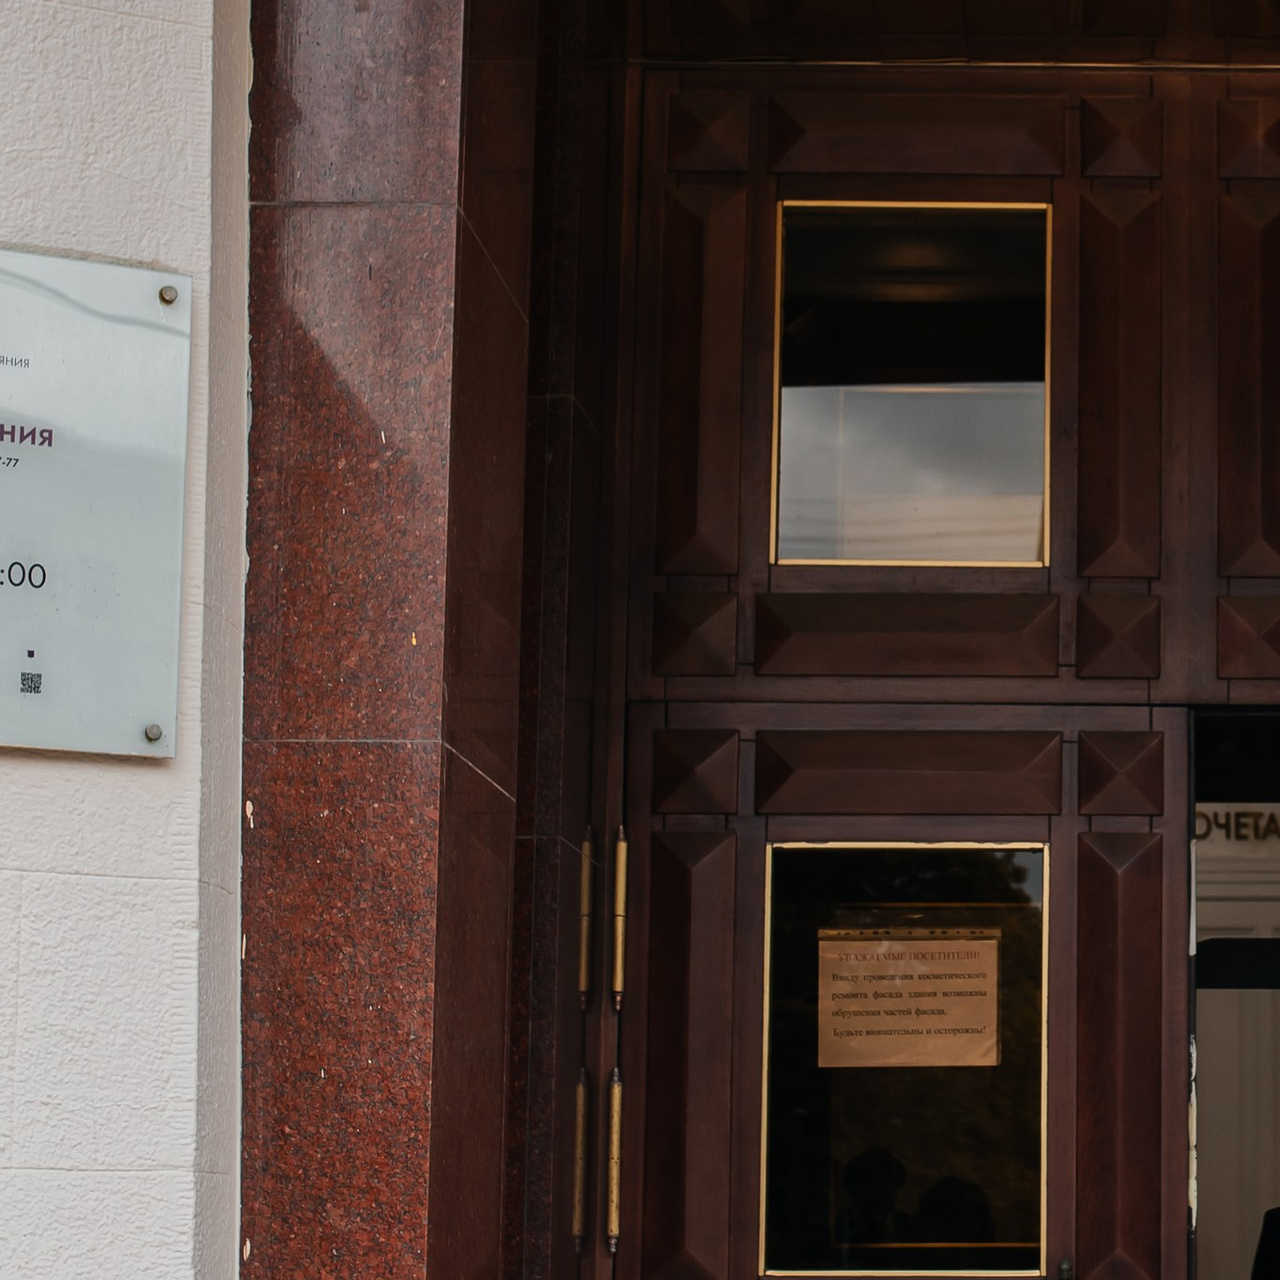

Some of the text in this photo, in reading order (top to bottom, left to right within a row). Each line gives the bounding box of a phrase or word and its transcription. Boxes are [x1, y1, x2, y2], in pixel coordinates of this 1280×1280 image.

[0, 456, 20, 467] -77
[838, 951, 980, 962] УВАЖАЕМЫЕ ПОСЕТИТЕЛИ!
[863, 973, 914, 983] проведения
[917, 972, 988, 980] косметического
[832, 992, 868, 1001] ремонта
[872, 990, 903, 1000] фасада
[832, 1009, 881, 1019] обрушения
[883, 1007, 913, 1016] частей
[833, 1028, 864, 1039] Будьте
[934, 1025, 986, 1037] осторожны!
